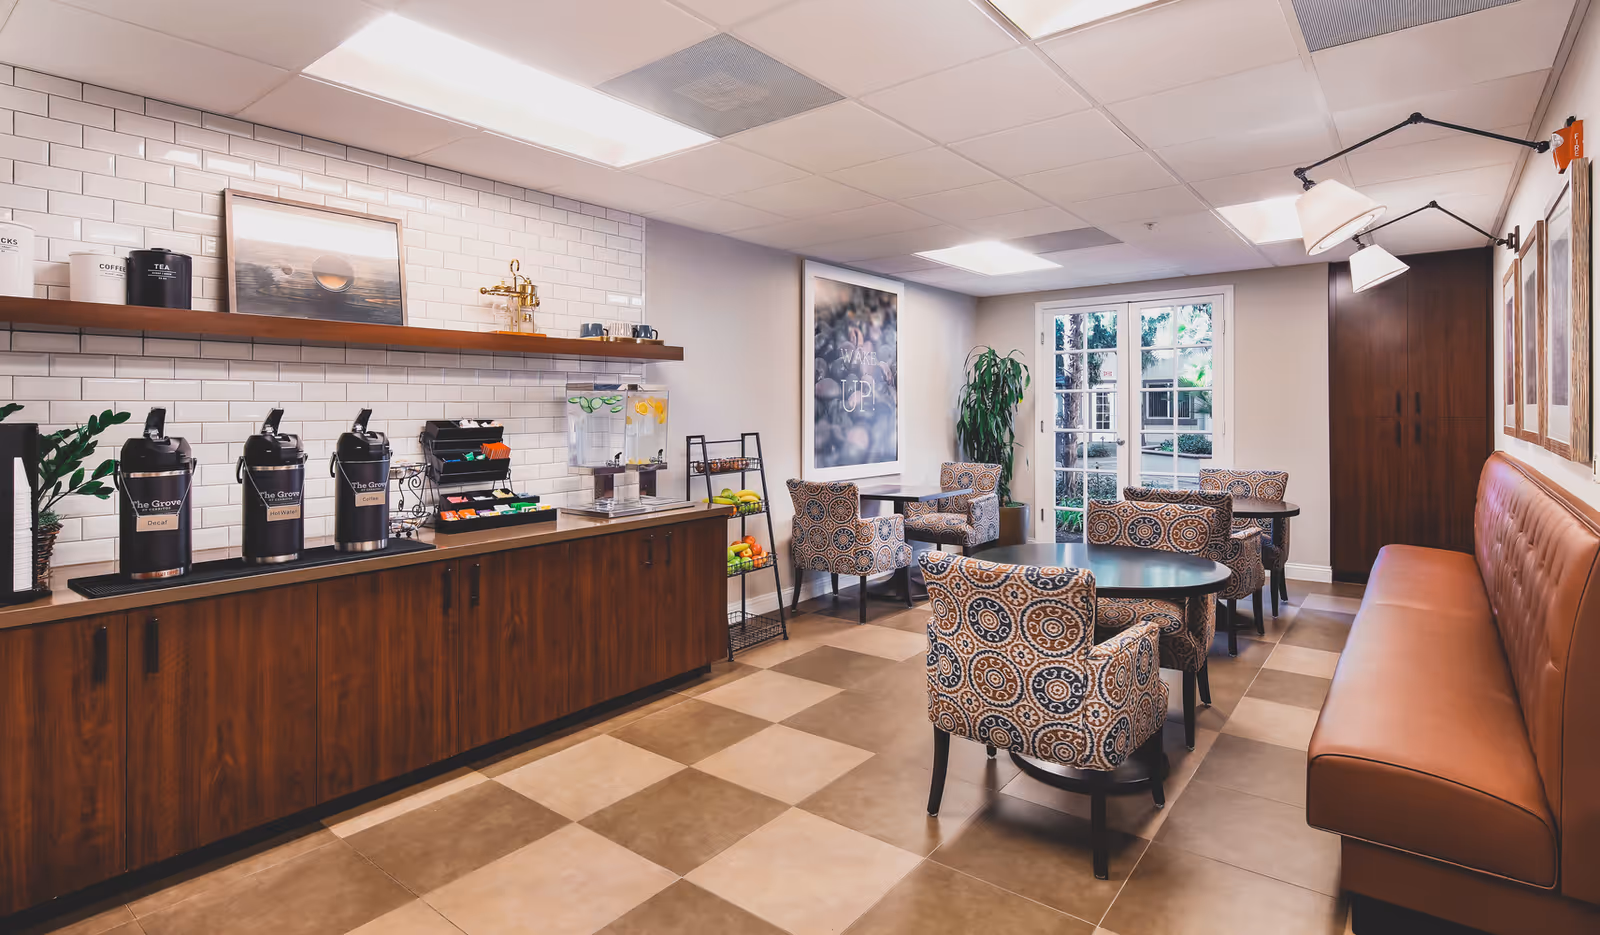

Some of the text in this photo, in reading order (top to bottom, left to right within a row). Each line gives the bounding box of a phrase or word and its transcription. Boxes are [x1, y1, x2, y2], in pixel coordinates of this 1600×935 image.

[841, 348, 877, 366] WAKE
[840, 379, 876, 413] UP!
[351, 481, 367, 489] The
[260, 491, 275, 499] The
[132, 499, 182, 509] The Grove
